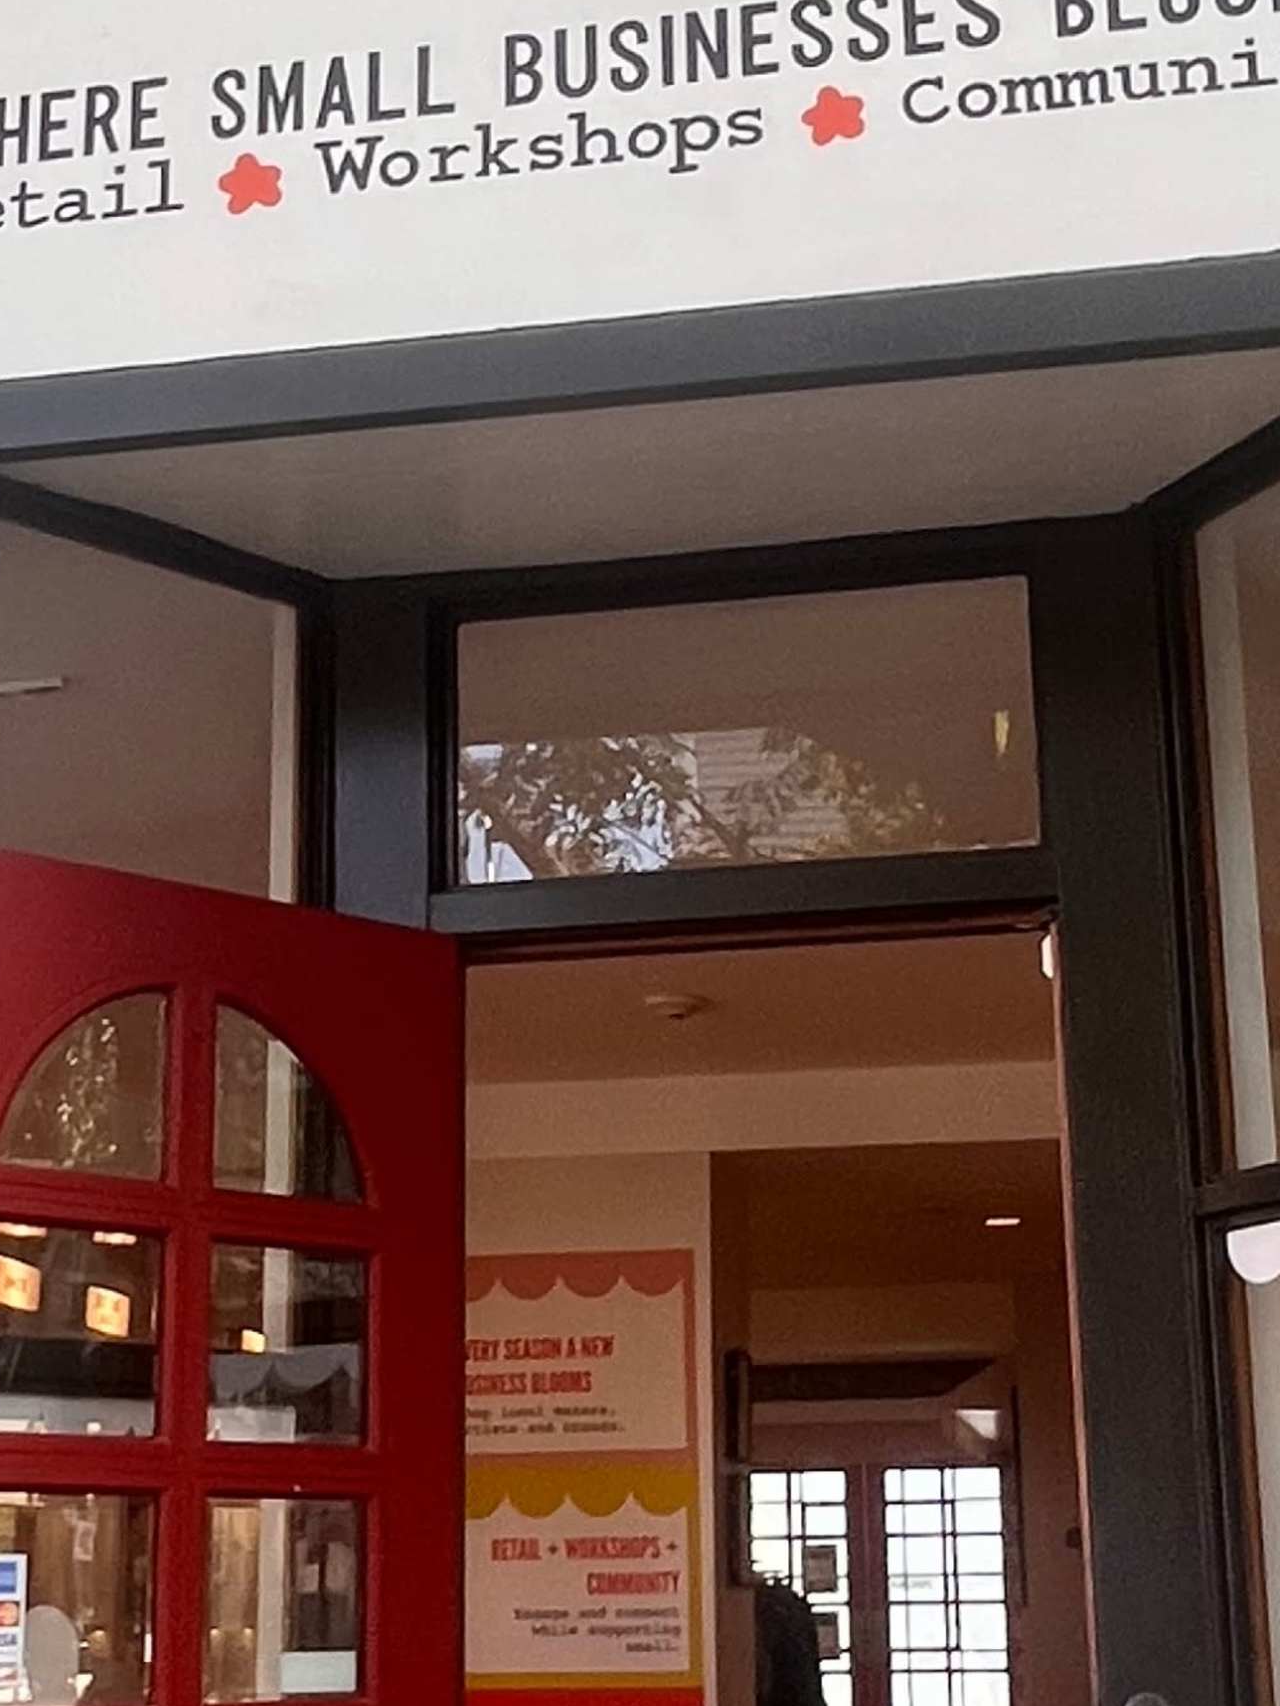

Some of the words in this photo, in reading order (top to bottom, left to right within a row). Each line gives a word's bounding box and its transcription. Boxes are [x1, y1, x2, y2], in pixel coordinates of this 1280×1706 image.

[209, 43, 458, 141] SMALL
[314, 103, 764, 195] Workshops
[491, 1537, 542, 1561] RETAIL
[563, 1536, 661, 1560] WORKSHOPS
[586, 1570, 682, 1596] COMMUNITY
